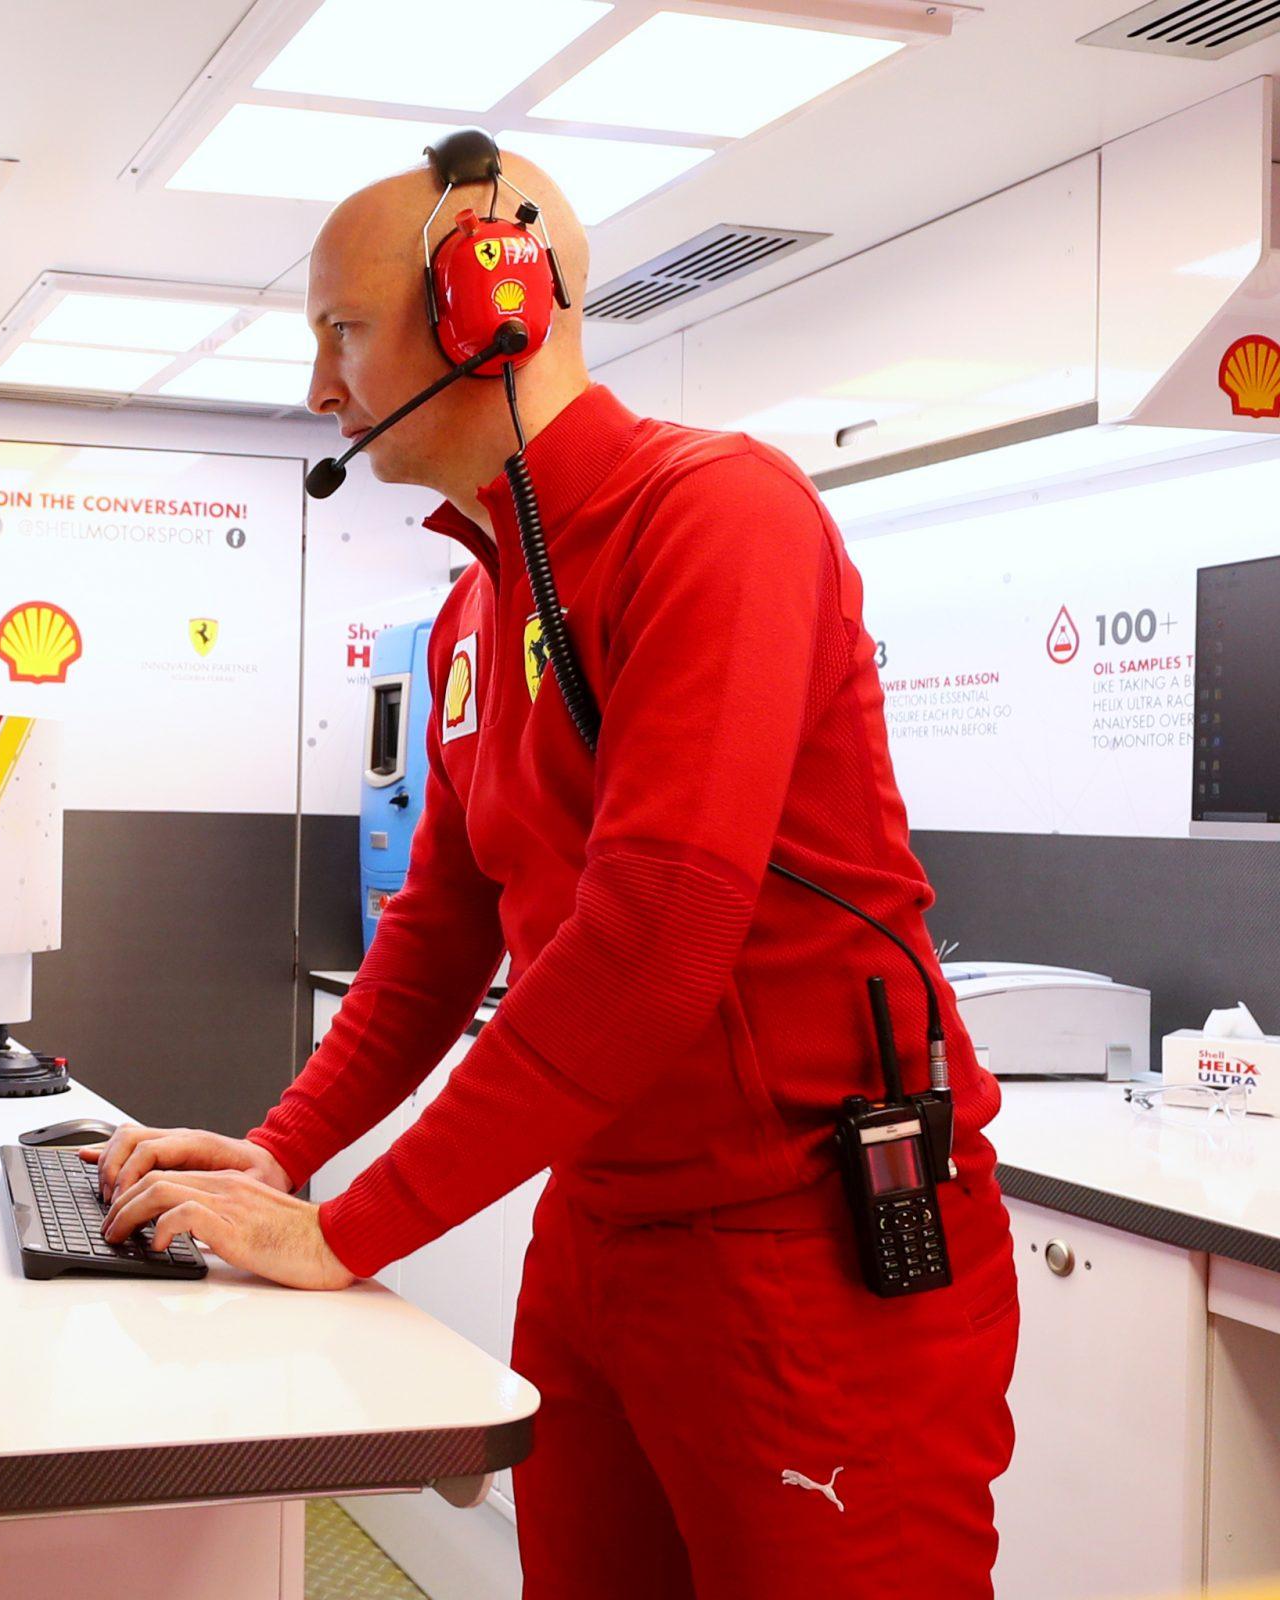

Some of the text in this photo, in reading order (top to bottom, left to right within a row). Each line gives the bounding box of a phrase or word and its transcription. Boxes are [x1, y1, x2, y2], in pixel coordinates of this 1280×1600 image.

[39, 492, 76, 511] THE
[82, 495, 248, 520] CONVERSATION!
[17, 517, 216, 546] @SHELLMOTORSPORT
[1095, 608, 1178, 646] 100+
[1093, 654, 1195, 676] OIL SAMPLES T
[879, 671, 1000, 692] OWER UNITS A SEASON
[1092, 673, 1195, 695] LIKE TAKING A B
[929, 692, 938, 705] IS
[939, 689, 990, 705] ESSENTIAL
[1092, 698, 1124, 713] HELIX
[1127, 695, 1163, 711] ULTRA
[922, 708, 949, 722] EACH
[951, 707, 964, 720] PU
[966, 705, 991, 719] CAN
[992, 703, 1013, 718] GO
[1092, 714, 1156, 730] ANALYSED
[891, 722, 999, 740] FURTHER THAN BEFORE
[1092, 735, 1110, 749] TO
[1112, 732, 1175, 749] MONITOR
[1198, 1049, 1225, 1060] Shell
[1197, 1057, 1262, 1076] HELIX
[1197, 1072, 1257, 1087] ULTRA
